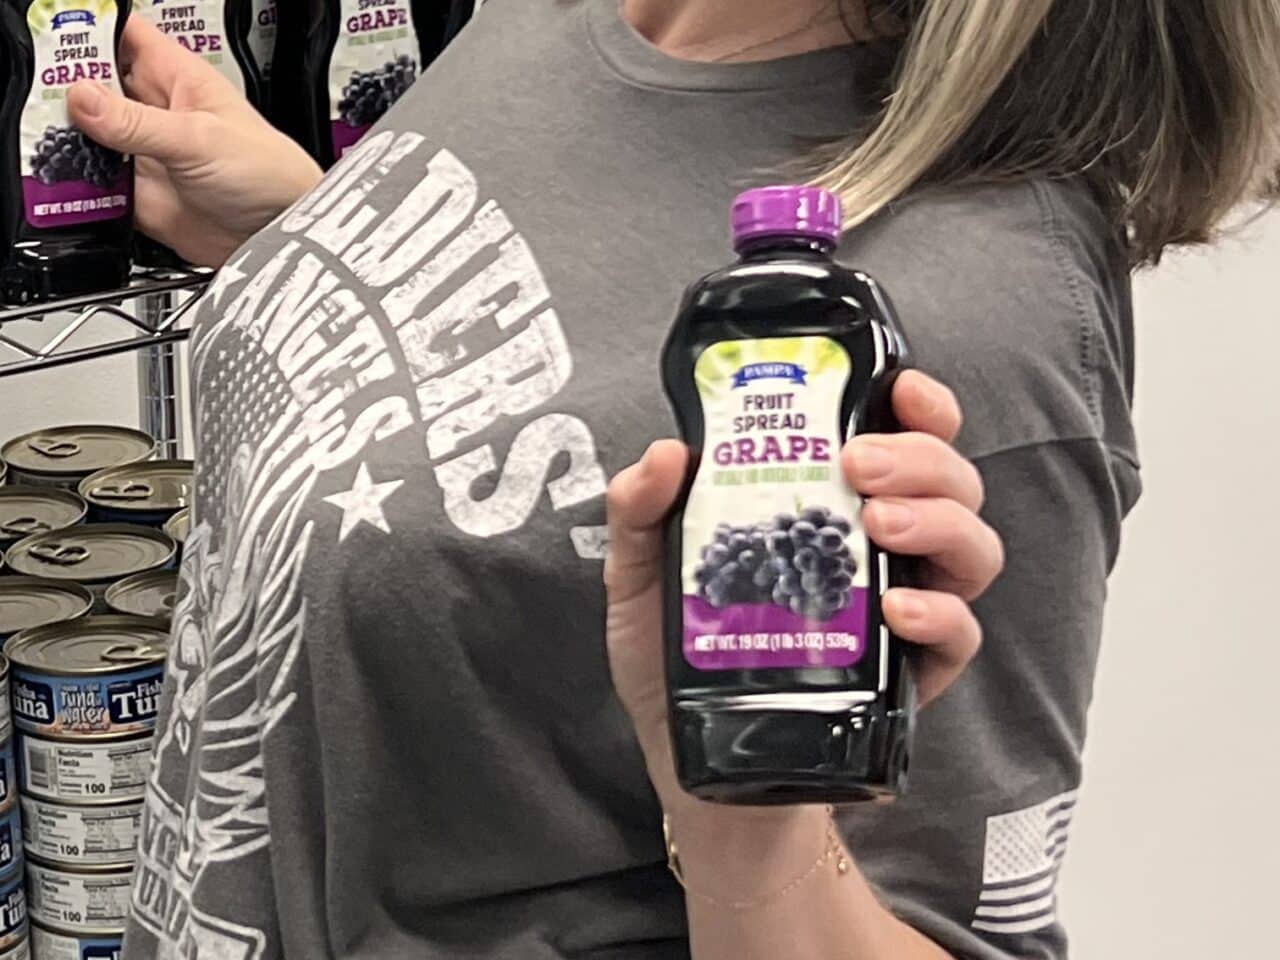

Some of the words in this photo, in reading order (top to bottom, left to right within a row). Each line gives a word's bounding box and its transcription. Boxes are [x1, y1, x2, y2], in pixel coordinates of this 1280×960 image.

[162, 6, 195, 20] FRUIT
[347, 9, 406, 33] GRAPE
[60, 32, 89, 46] FRUIT
[178, 35, 222, 52] APE
[55, 47, 98, 62] SPREAD
[42, 62, 112, 86] GRAPE
[224, 240, 415, 473] ANGELS
[743, 394, 794, 411] FRUIT
[733, 414, 806, 433] SPREAD
[714, 436, 830, 465] GRAPE
[739, 634, 751, 649] 19
[795, 633, 803, 648] 3
[826, 633, 857, 651] 539g
[138, 682, 162, 696] Fish
[15, 699, 49, 719] una
[85, 783, 105, 794] 100
[59, 845, 79, 856] 100
[63, 911, 81, 922] 100
